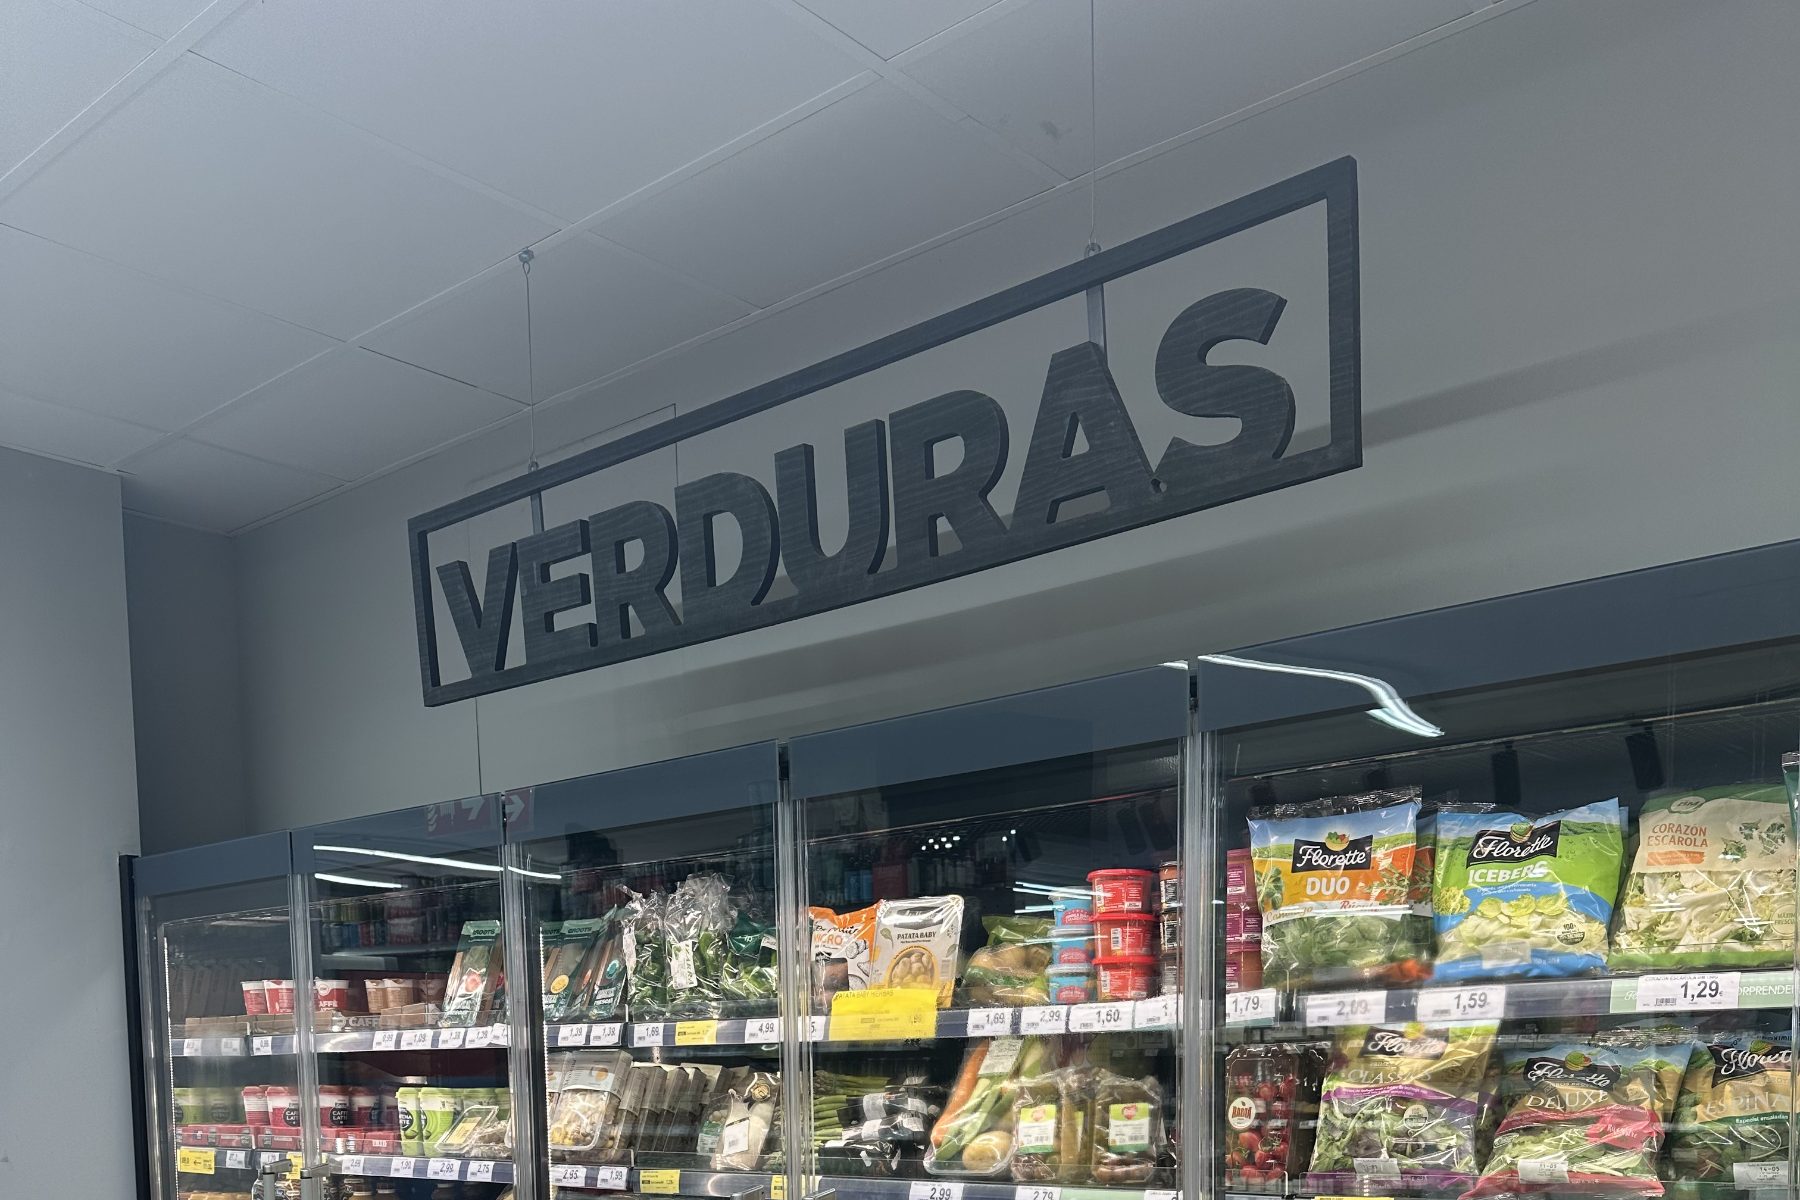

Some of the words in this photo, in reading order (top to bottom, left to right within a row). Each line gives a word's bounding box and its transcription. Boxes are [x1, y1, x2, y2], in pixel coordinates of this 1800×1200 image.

[436, 287, 1297, 678] VERDURAS
[1473, 834, 1554, 858] Florette
[1647, 835, 1708, 848] ESCAROLA
[1296, 845, 1366, 867] Florette
[1468, 861, 1548, 884] ICEBERG
[1306, 877, 1350, 895] DUO
[1738, 985, 1793, 996] ORPRENDE
[1720, 1047, 1792, 1075] Floret
